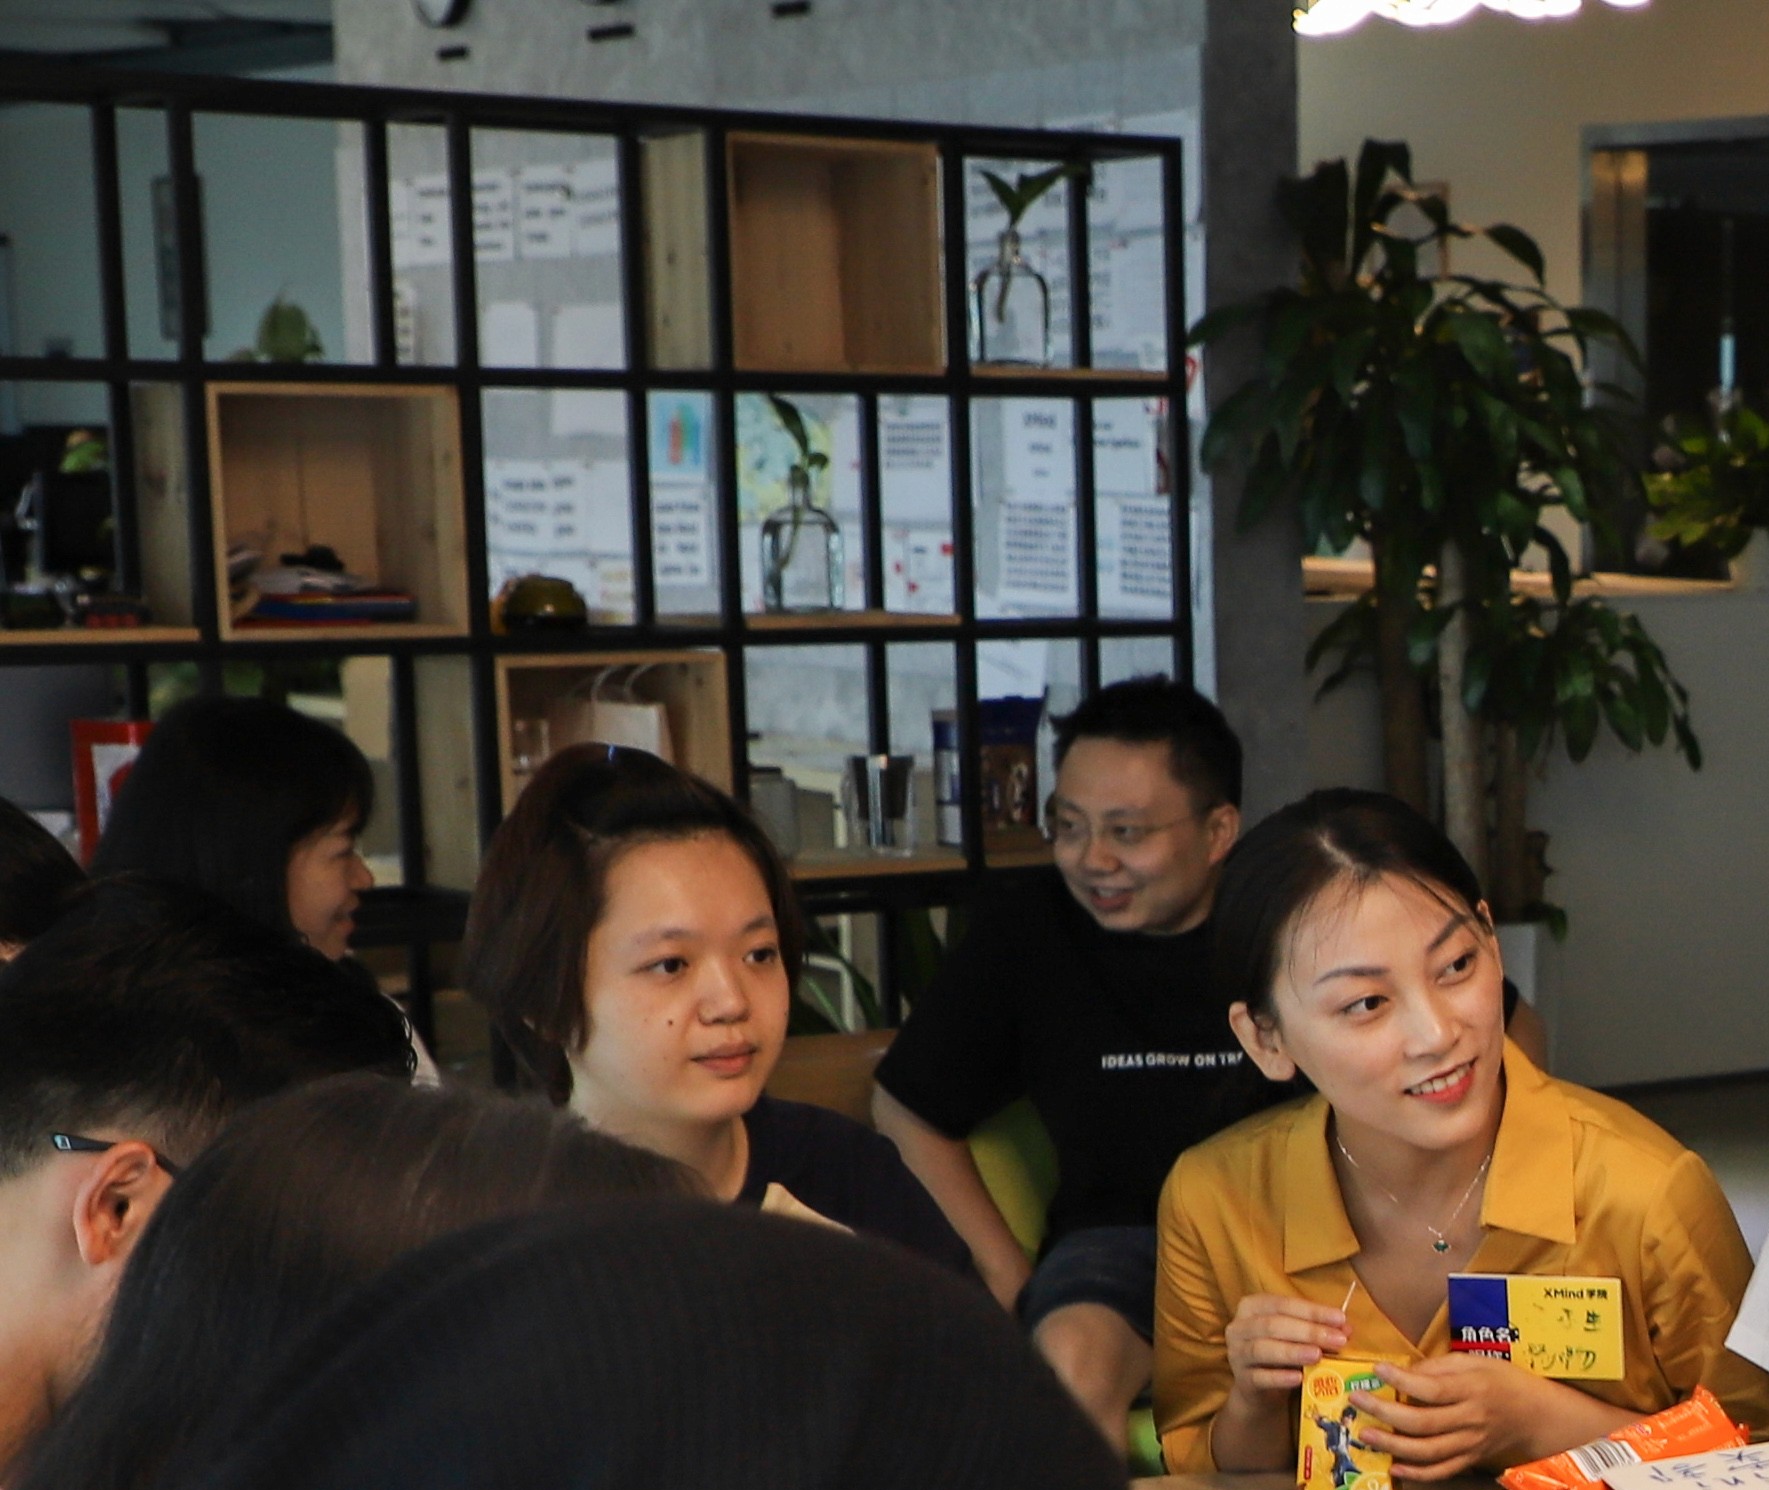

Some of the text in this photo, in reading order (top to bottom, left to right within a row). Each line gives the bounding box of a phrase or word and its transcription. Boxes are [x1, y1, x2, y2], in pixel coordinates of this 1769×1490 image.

[1101, 1053, 1143, 1069] IDEAS
[1145, 1052, 1191, 1067] GROW
[1194, 1052, 1217, 1067] ON
[1544, 1287, 1584, 1300] XMind
